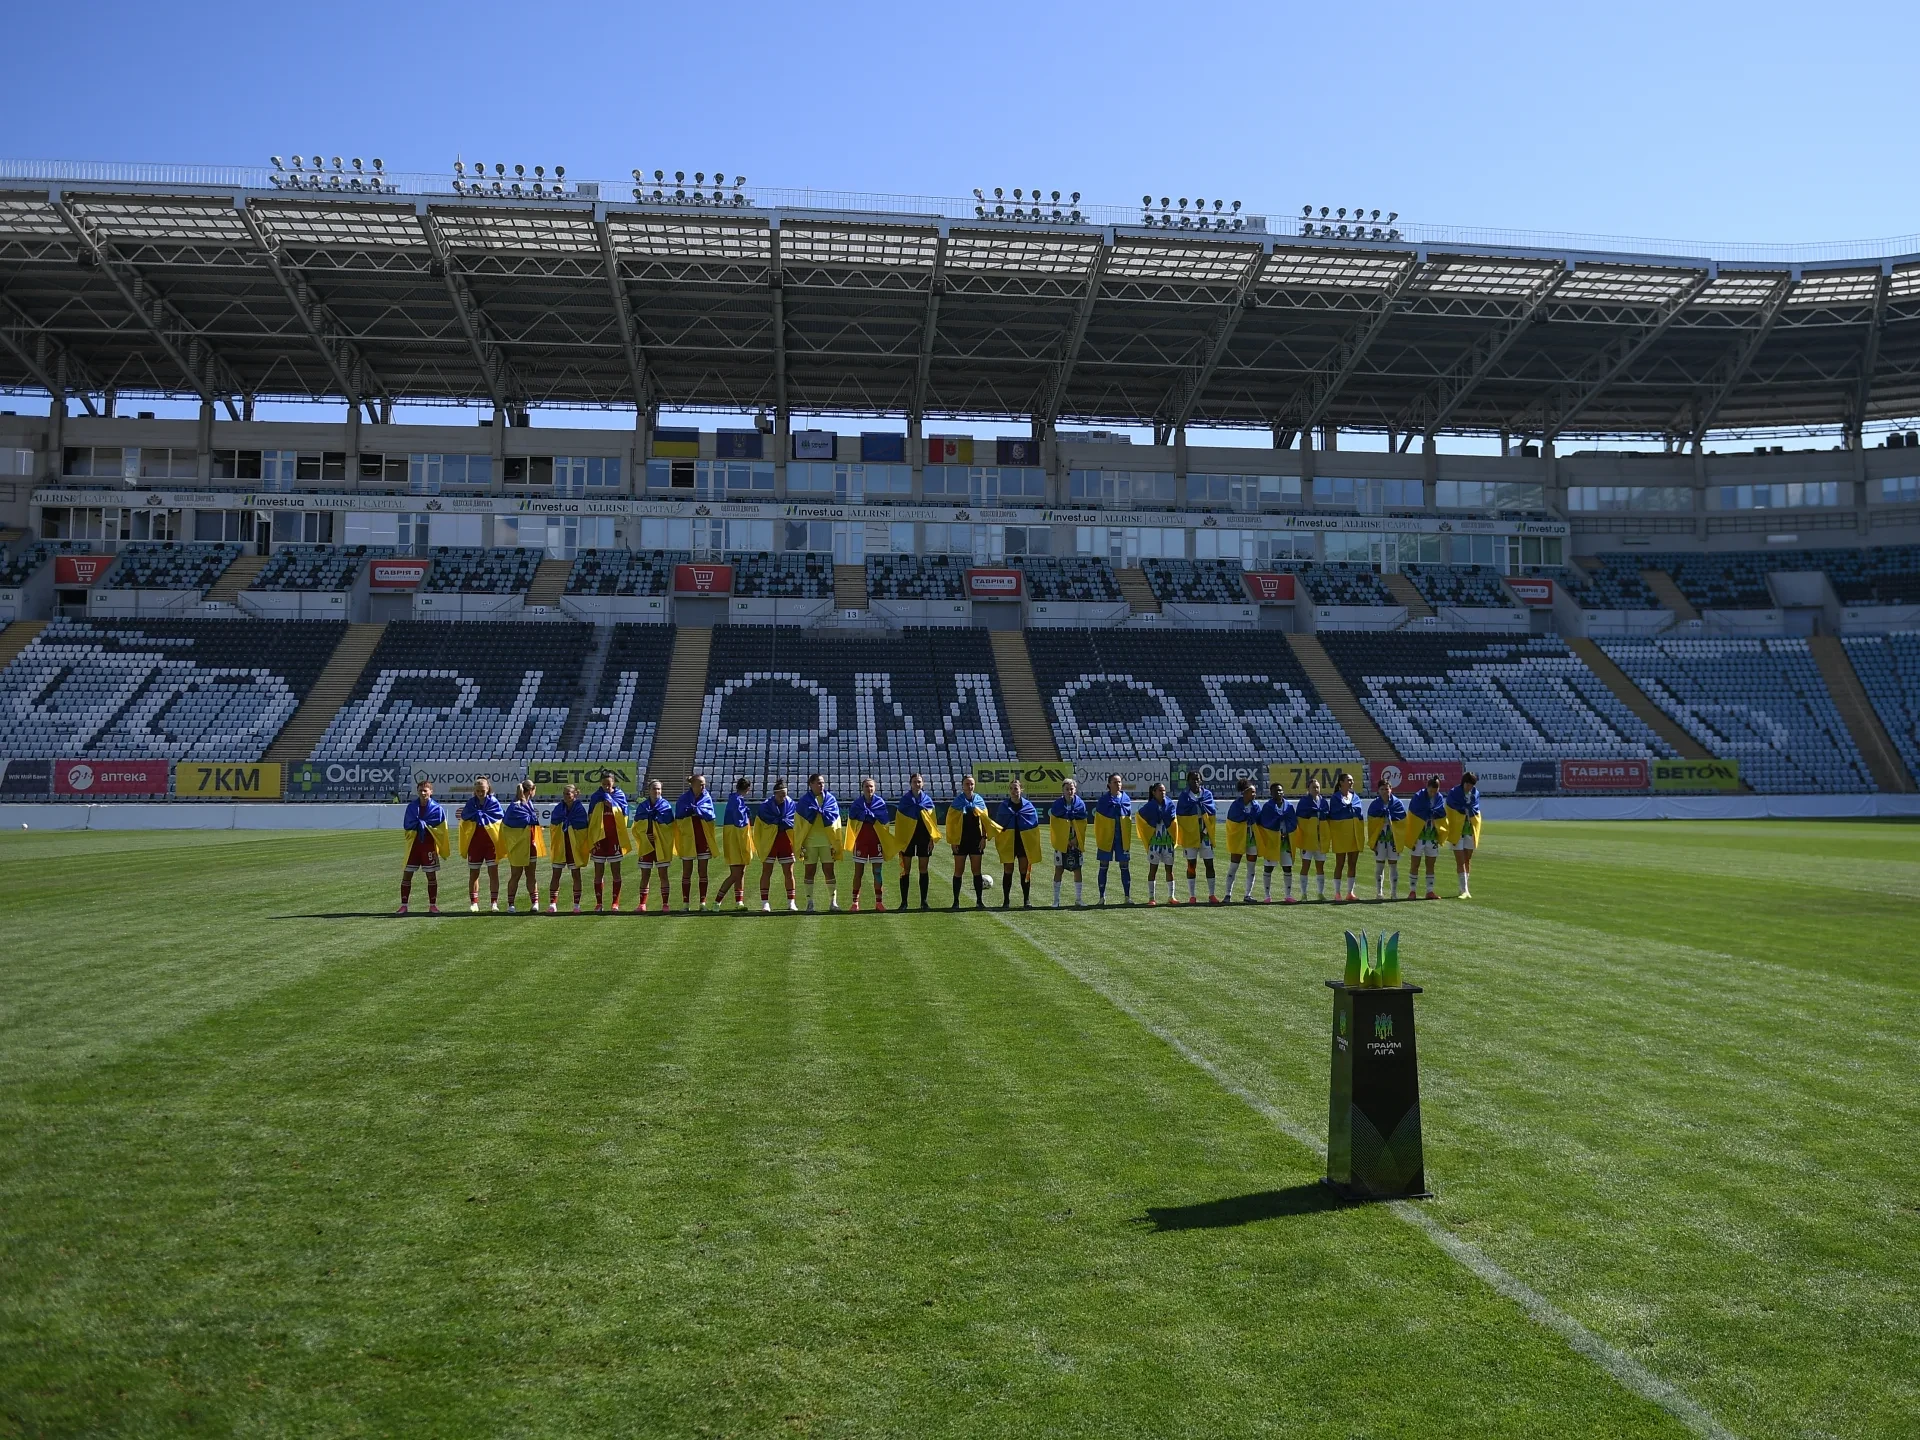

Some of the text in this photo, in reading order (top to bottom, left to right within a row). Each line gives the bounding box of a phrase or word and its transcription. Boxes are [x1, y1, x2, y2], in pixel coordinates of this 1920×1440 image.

[84, 495, 126, 503] CAPITAL
[256, 497, 304, 507] invest.ua
[312, 499, 405, 509] ALLRISE CAPITAL
[532, 502, 578, 512] invest.ua
[586, 504, 676, 514] ALLRISE CAPITAL
[798, 507, 843, 517] invest.ua
[850, 509, 937, 519] ALLRISE CAPITAL
[1053, 512, 1096, 522] invest.ua
[1103, 515, 1186, 524] ALLRISE CAPITAL
[1296, 519, 1337, 529] invest.ua
[1343, 520, 1422, 530] ALLRISE CAPITAL
[1527, 524, 1565, 534] invest.ua
[534, 607, 545, 615] 12
[326, 763, 395, 783] Odrex
[1199, 764, 1258, 781] Odrex
[1569, 767, 1625, 776] ТАВРІЯ
[101, 772, 147, 782] аптека
[1088, 772, 1169, 782] УКРХОРОНА
[1367, 1040, 1402, 1049] ПРАЙМ
